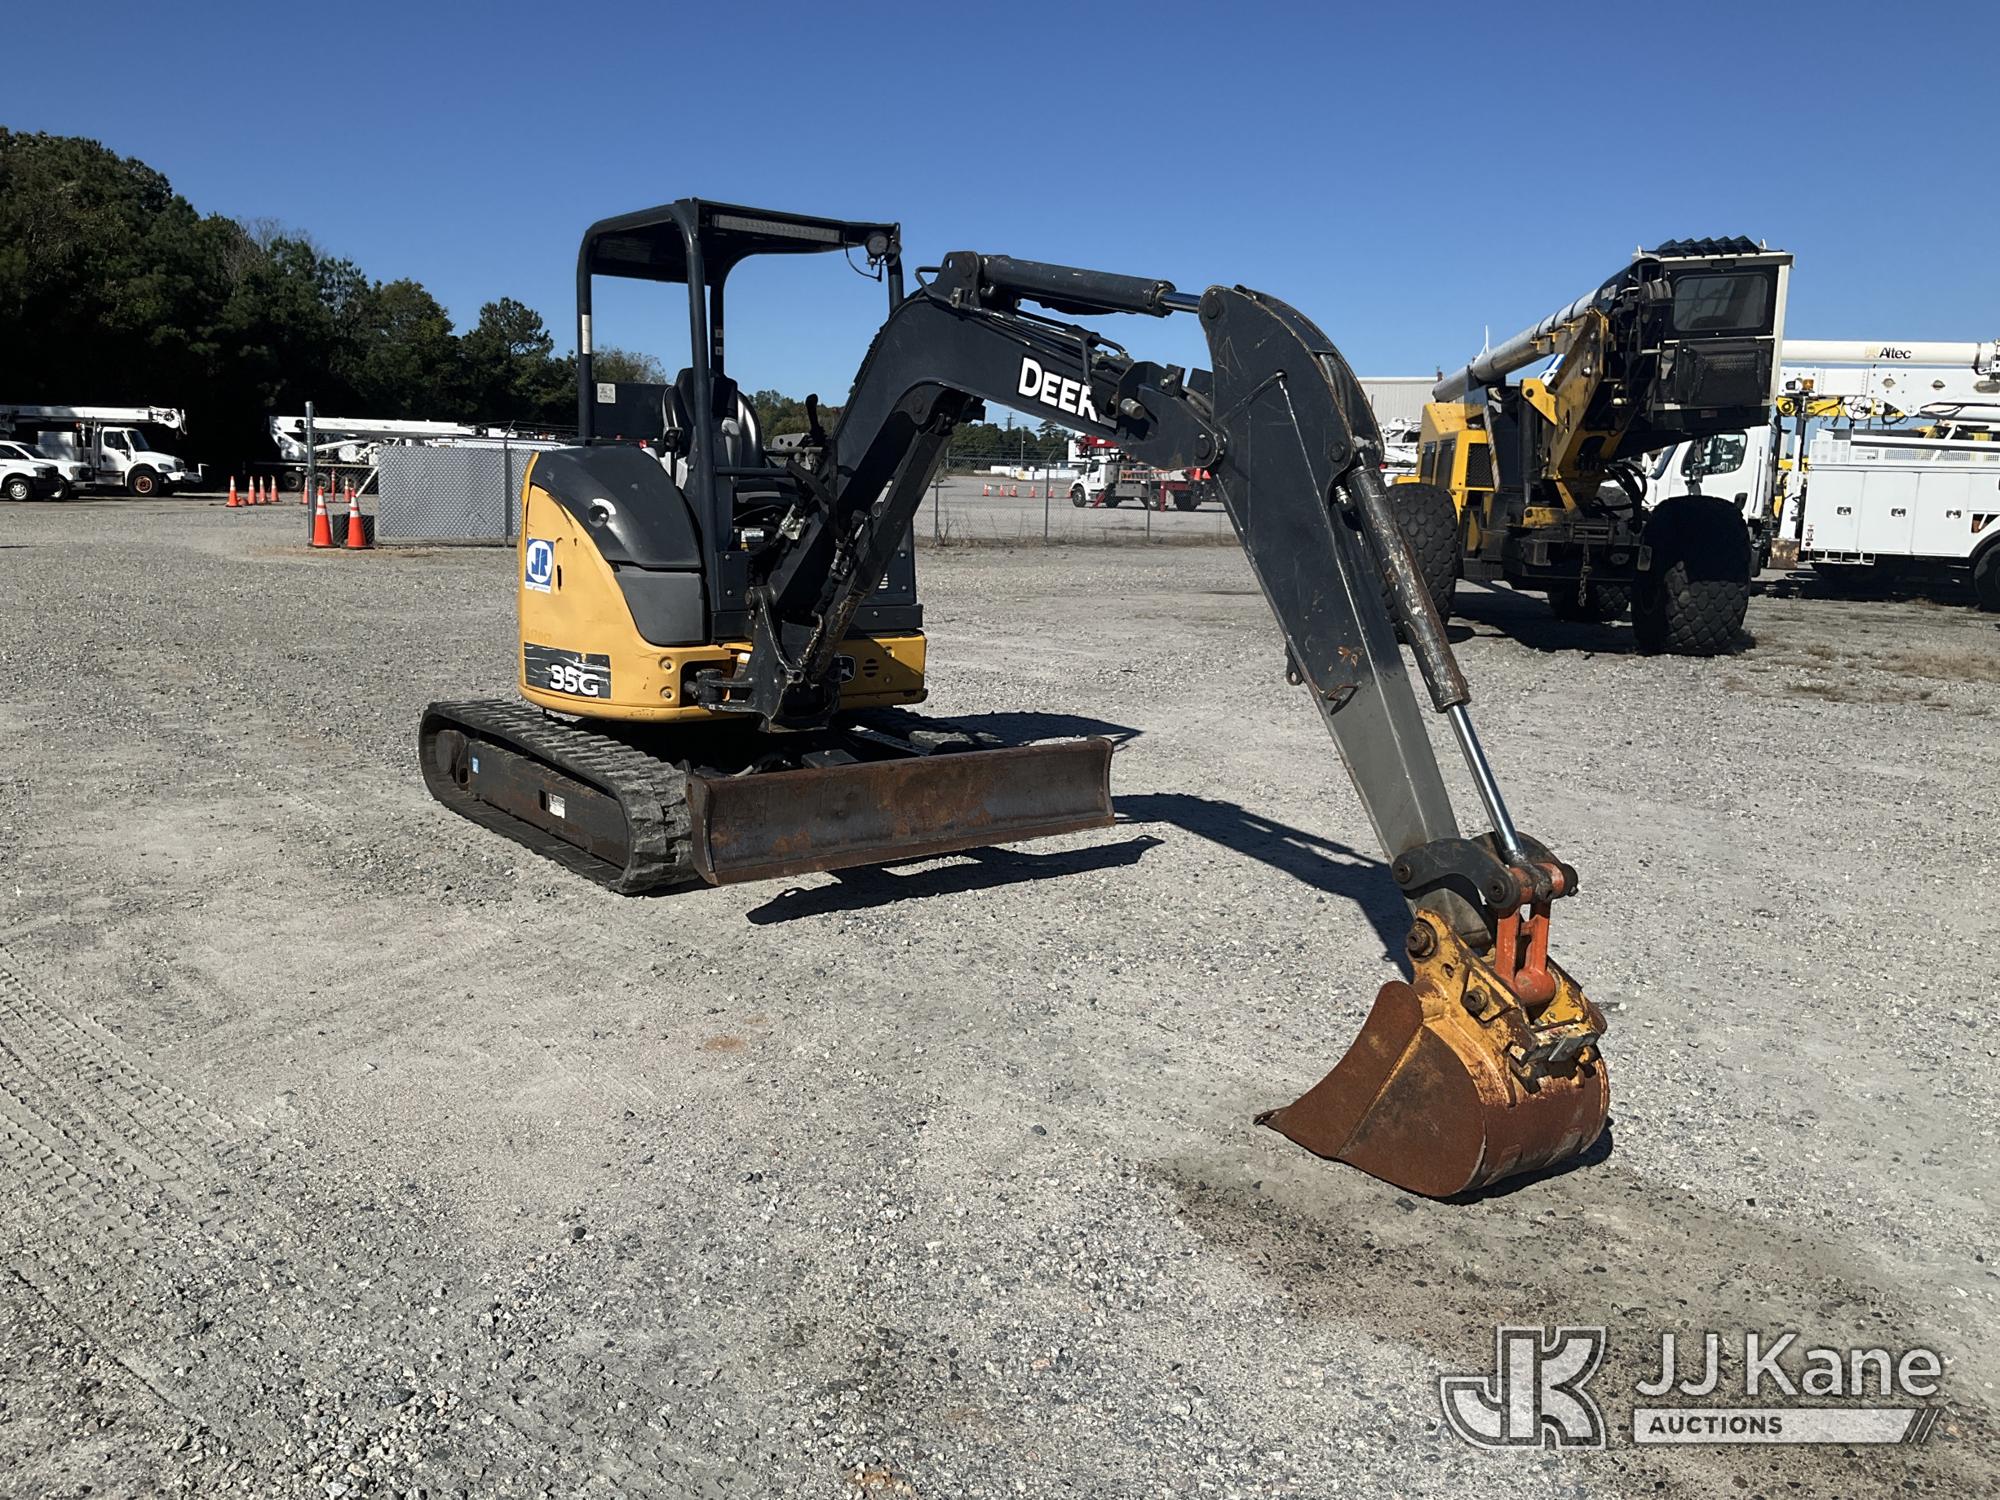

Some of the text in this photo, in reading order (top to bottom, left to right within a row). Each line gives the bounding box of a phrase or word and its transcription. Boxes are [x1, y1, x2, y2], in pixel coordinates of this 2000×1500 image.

[1879, 347, 1912, 359] Altec
[1018, 357, 1118, 429] DEER
[550, 664, 599, 696] 35G
